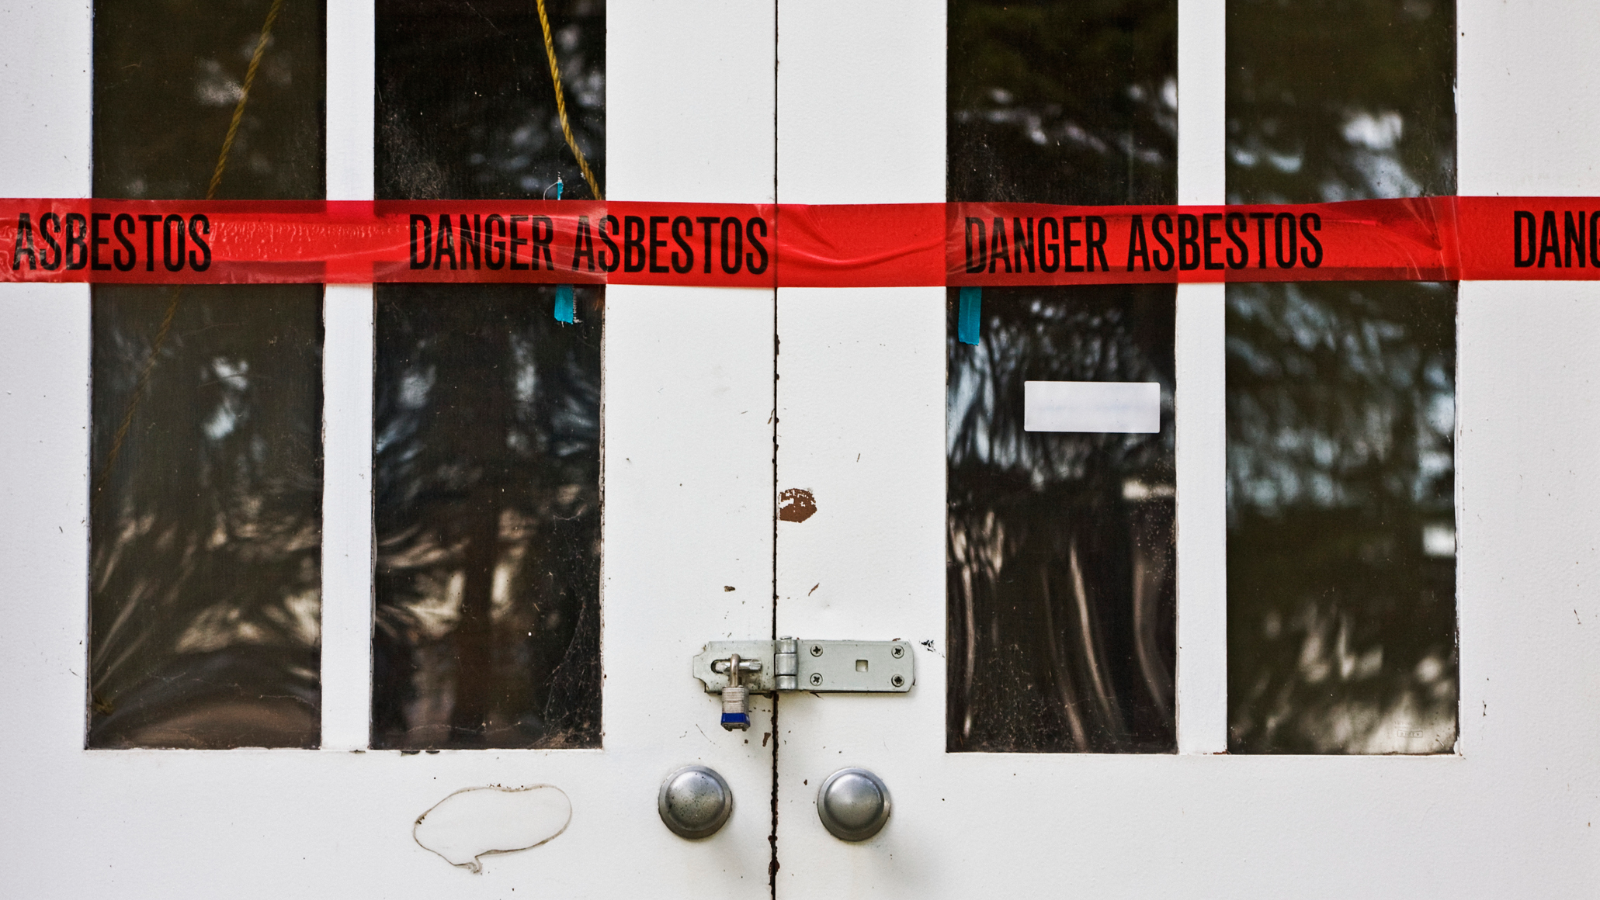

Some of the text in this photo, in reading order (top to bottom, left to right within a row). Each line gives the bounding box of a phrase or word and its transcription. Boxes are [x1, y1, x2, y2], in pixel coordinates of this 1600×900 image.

[12, 212, 211, 272] ASBESTOS
[410, 214, 554, 271] DANGER
[572, 215, 769, 275] ASBESTOS
[965, 215, 1109, 274] DANGER
[1127, 212, 1323, 271] ASBESTOS
